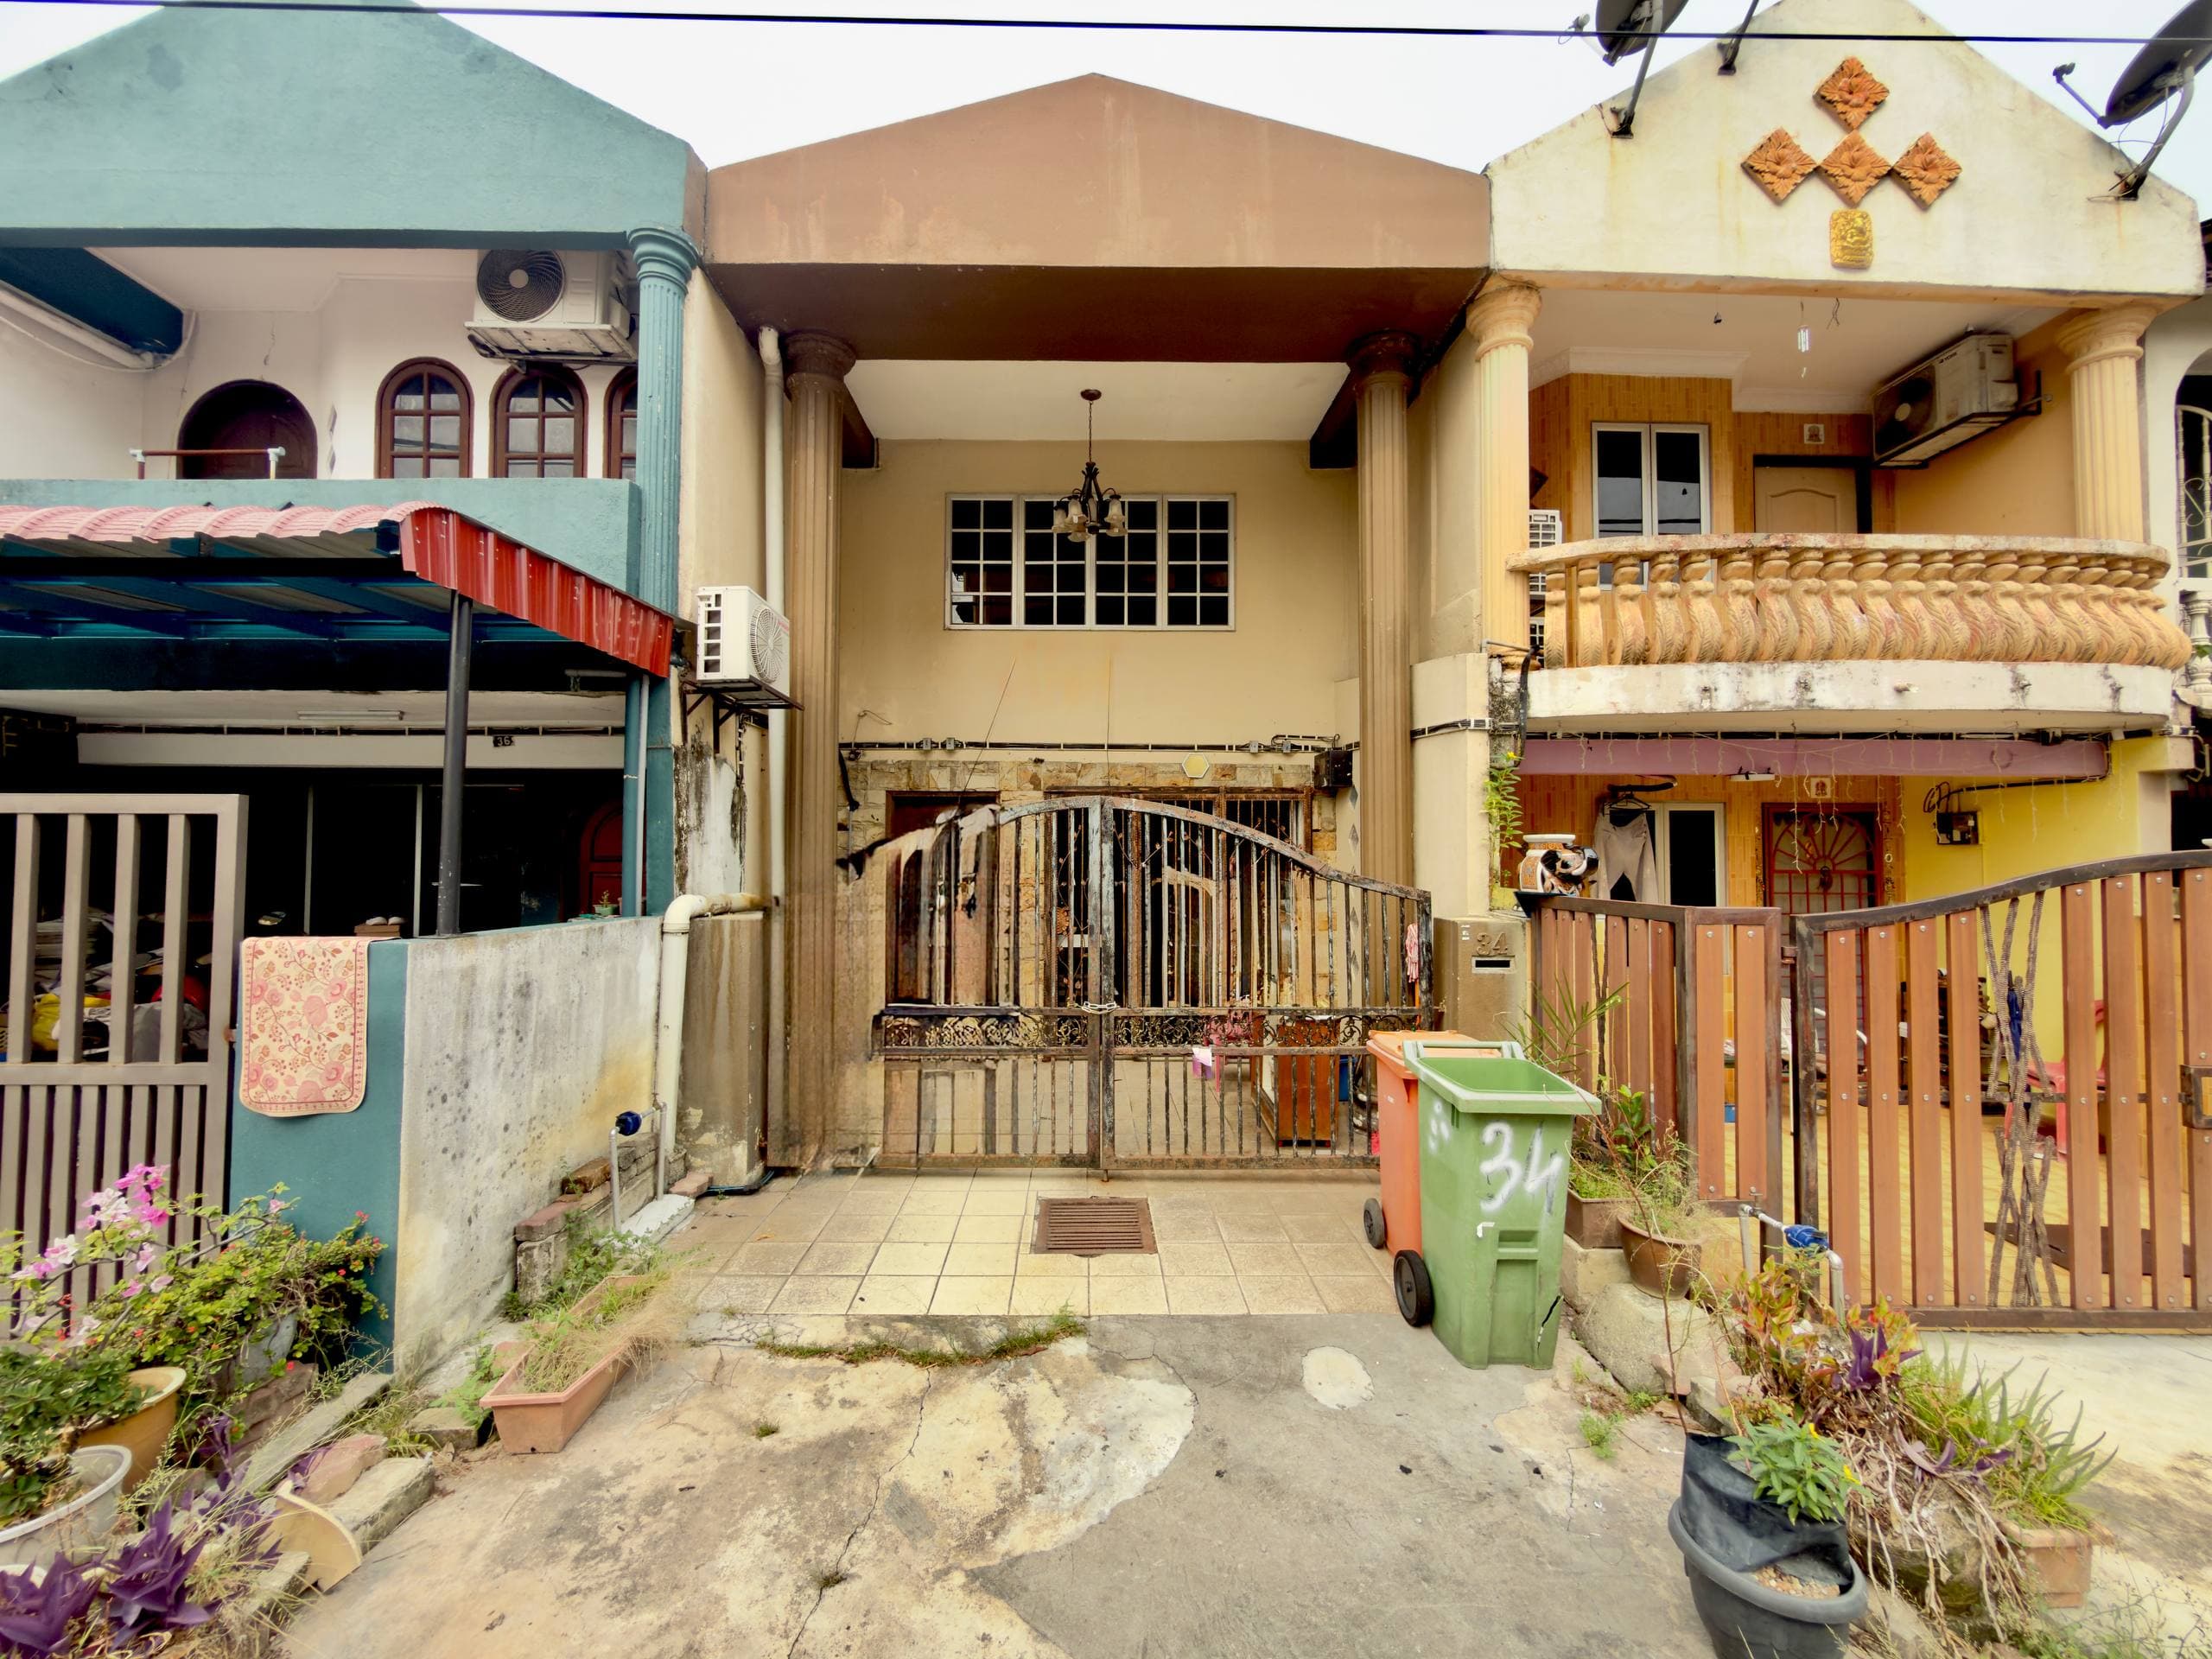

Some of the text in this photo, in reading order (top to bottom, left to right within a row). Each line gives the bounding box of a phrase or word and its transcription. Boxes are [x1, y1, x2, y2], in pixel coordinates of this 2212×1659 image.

[497, 735, 511, 747] 36
[1476, 932, 1509, 956] 34
[1479, 1120, 1564, 1215] 34
